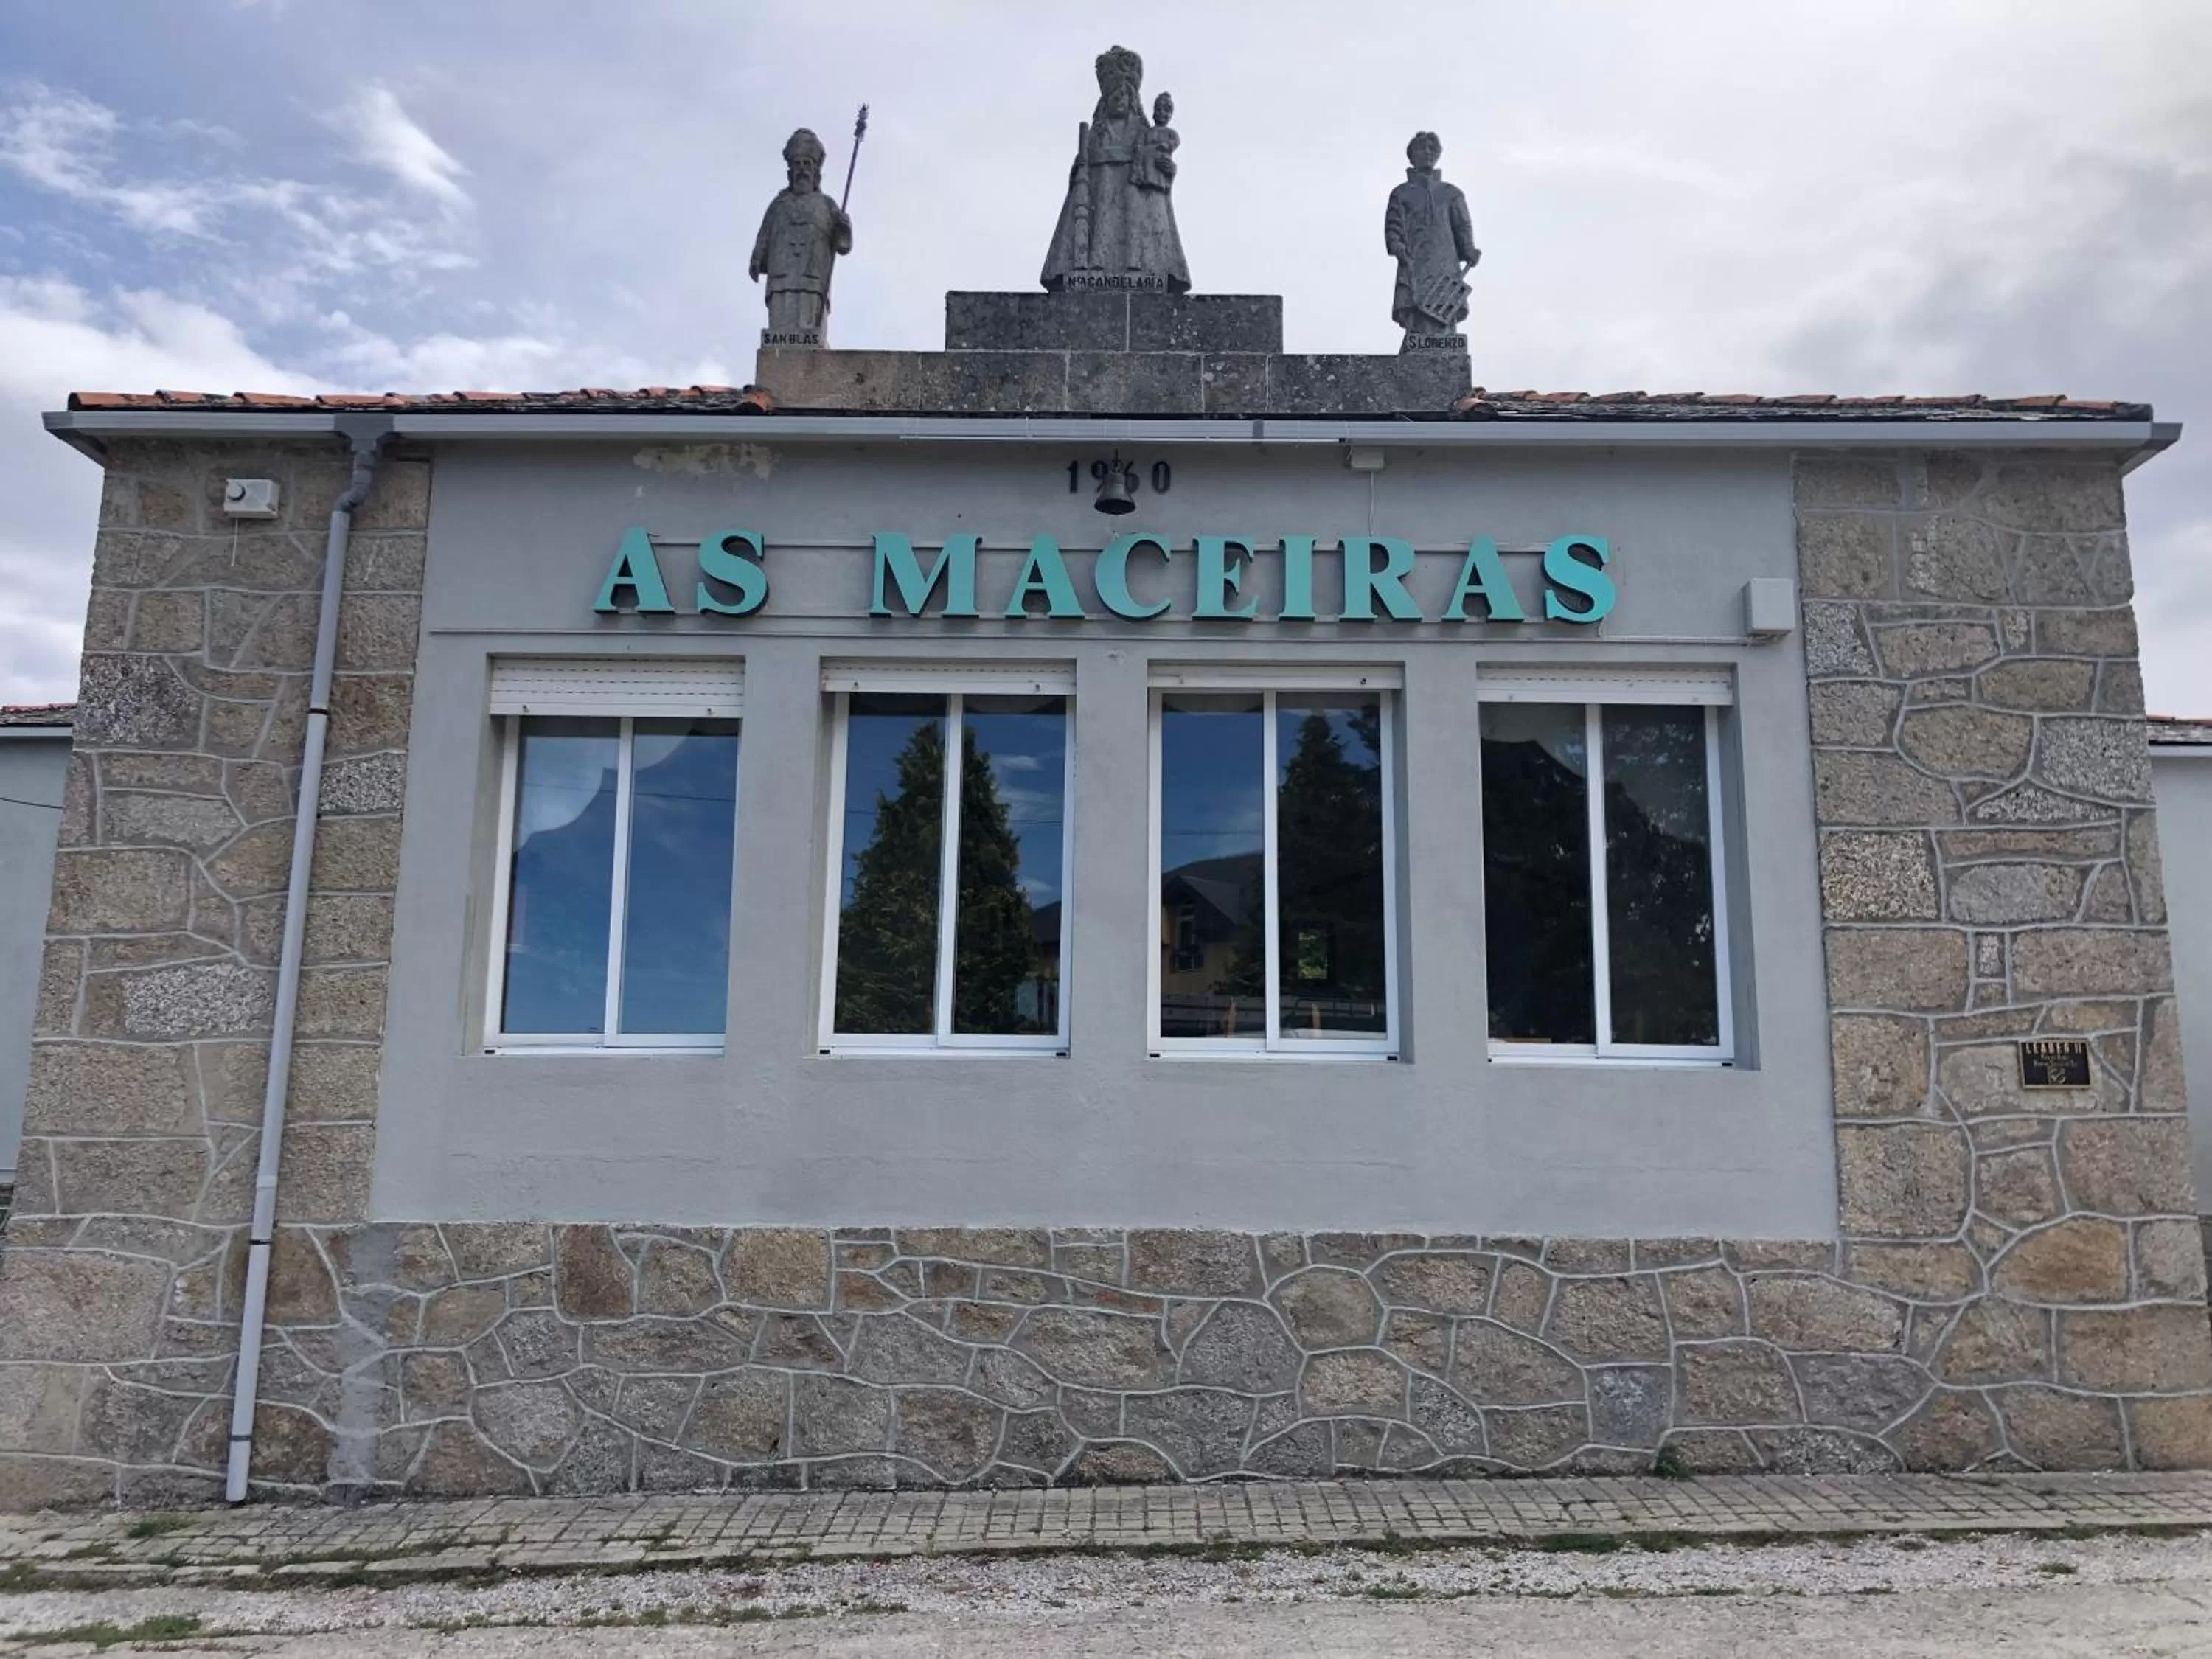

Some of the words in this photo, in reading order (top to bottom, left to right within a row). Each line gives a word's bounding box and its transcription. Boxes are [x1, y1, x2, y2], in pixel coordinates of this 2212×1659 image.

[764, 334, 787, 344] SAN
[1067, 460, 1172, 494] 1960
[593, 526, 769, 617] AS
[869, 532, 1617, 623] MACEIRAS
